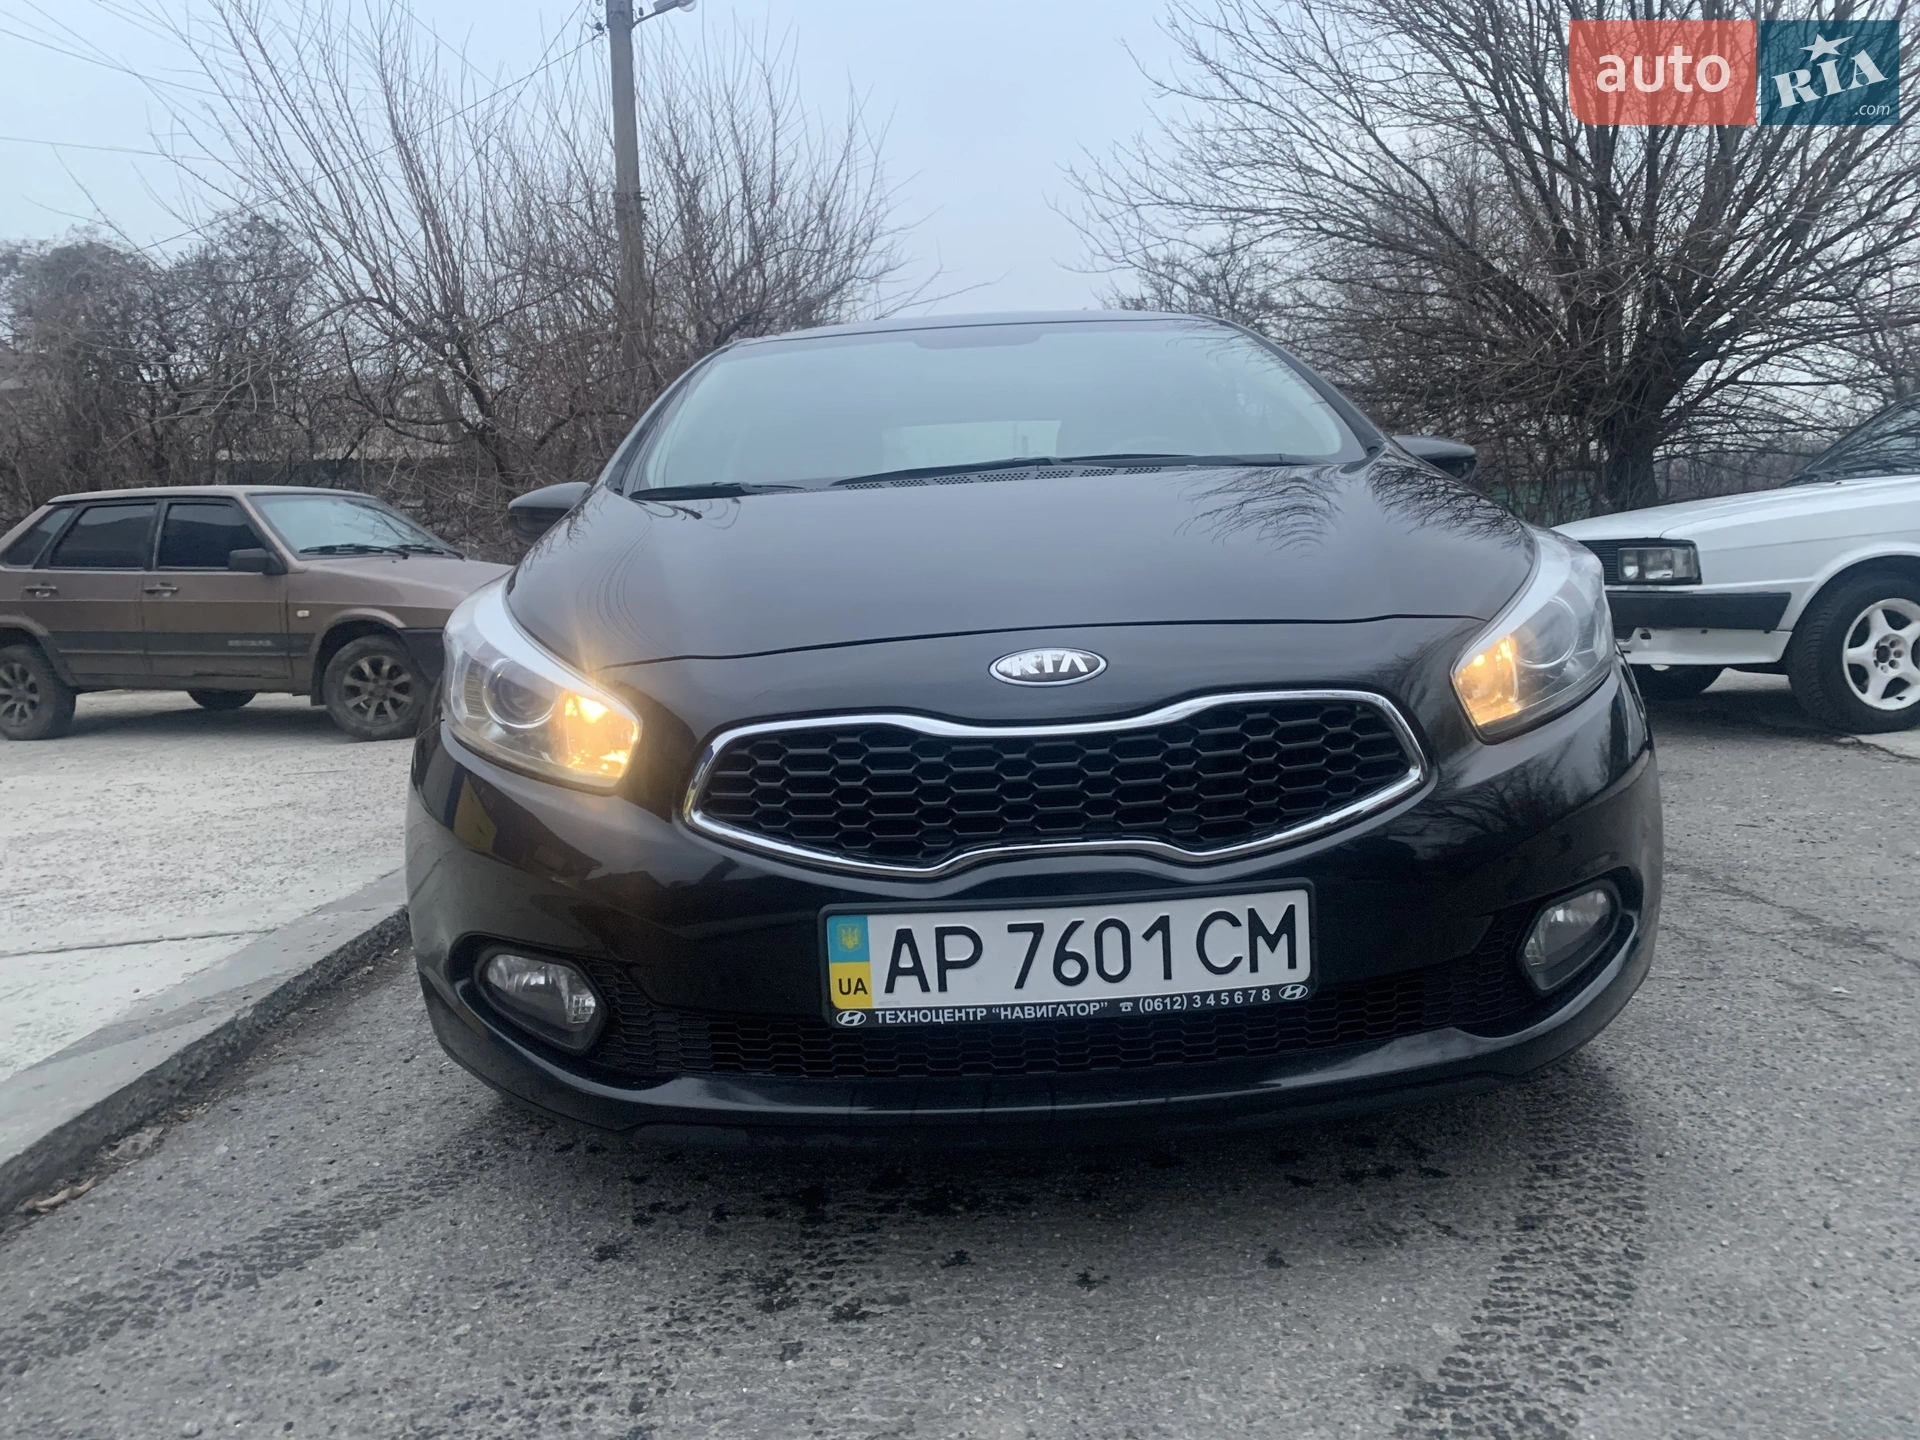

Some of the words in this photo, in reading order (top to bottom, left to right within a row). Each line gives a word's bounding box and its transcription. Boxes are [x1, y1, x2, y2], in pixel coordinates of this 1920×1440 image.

[1011, 651, 1089, 677] KIA
[884, 925, 983, 994] AP
[1007, 914, 1172, 989] 7601
[1195, 904, 1297, 975] CM
[838, 978, 868, 996] UA
[875, 1007, 987, 1024] ТЕХНОЦЕНТР
[1139, 994, 1188, 1014] (0612)
